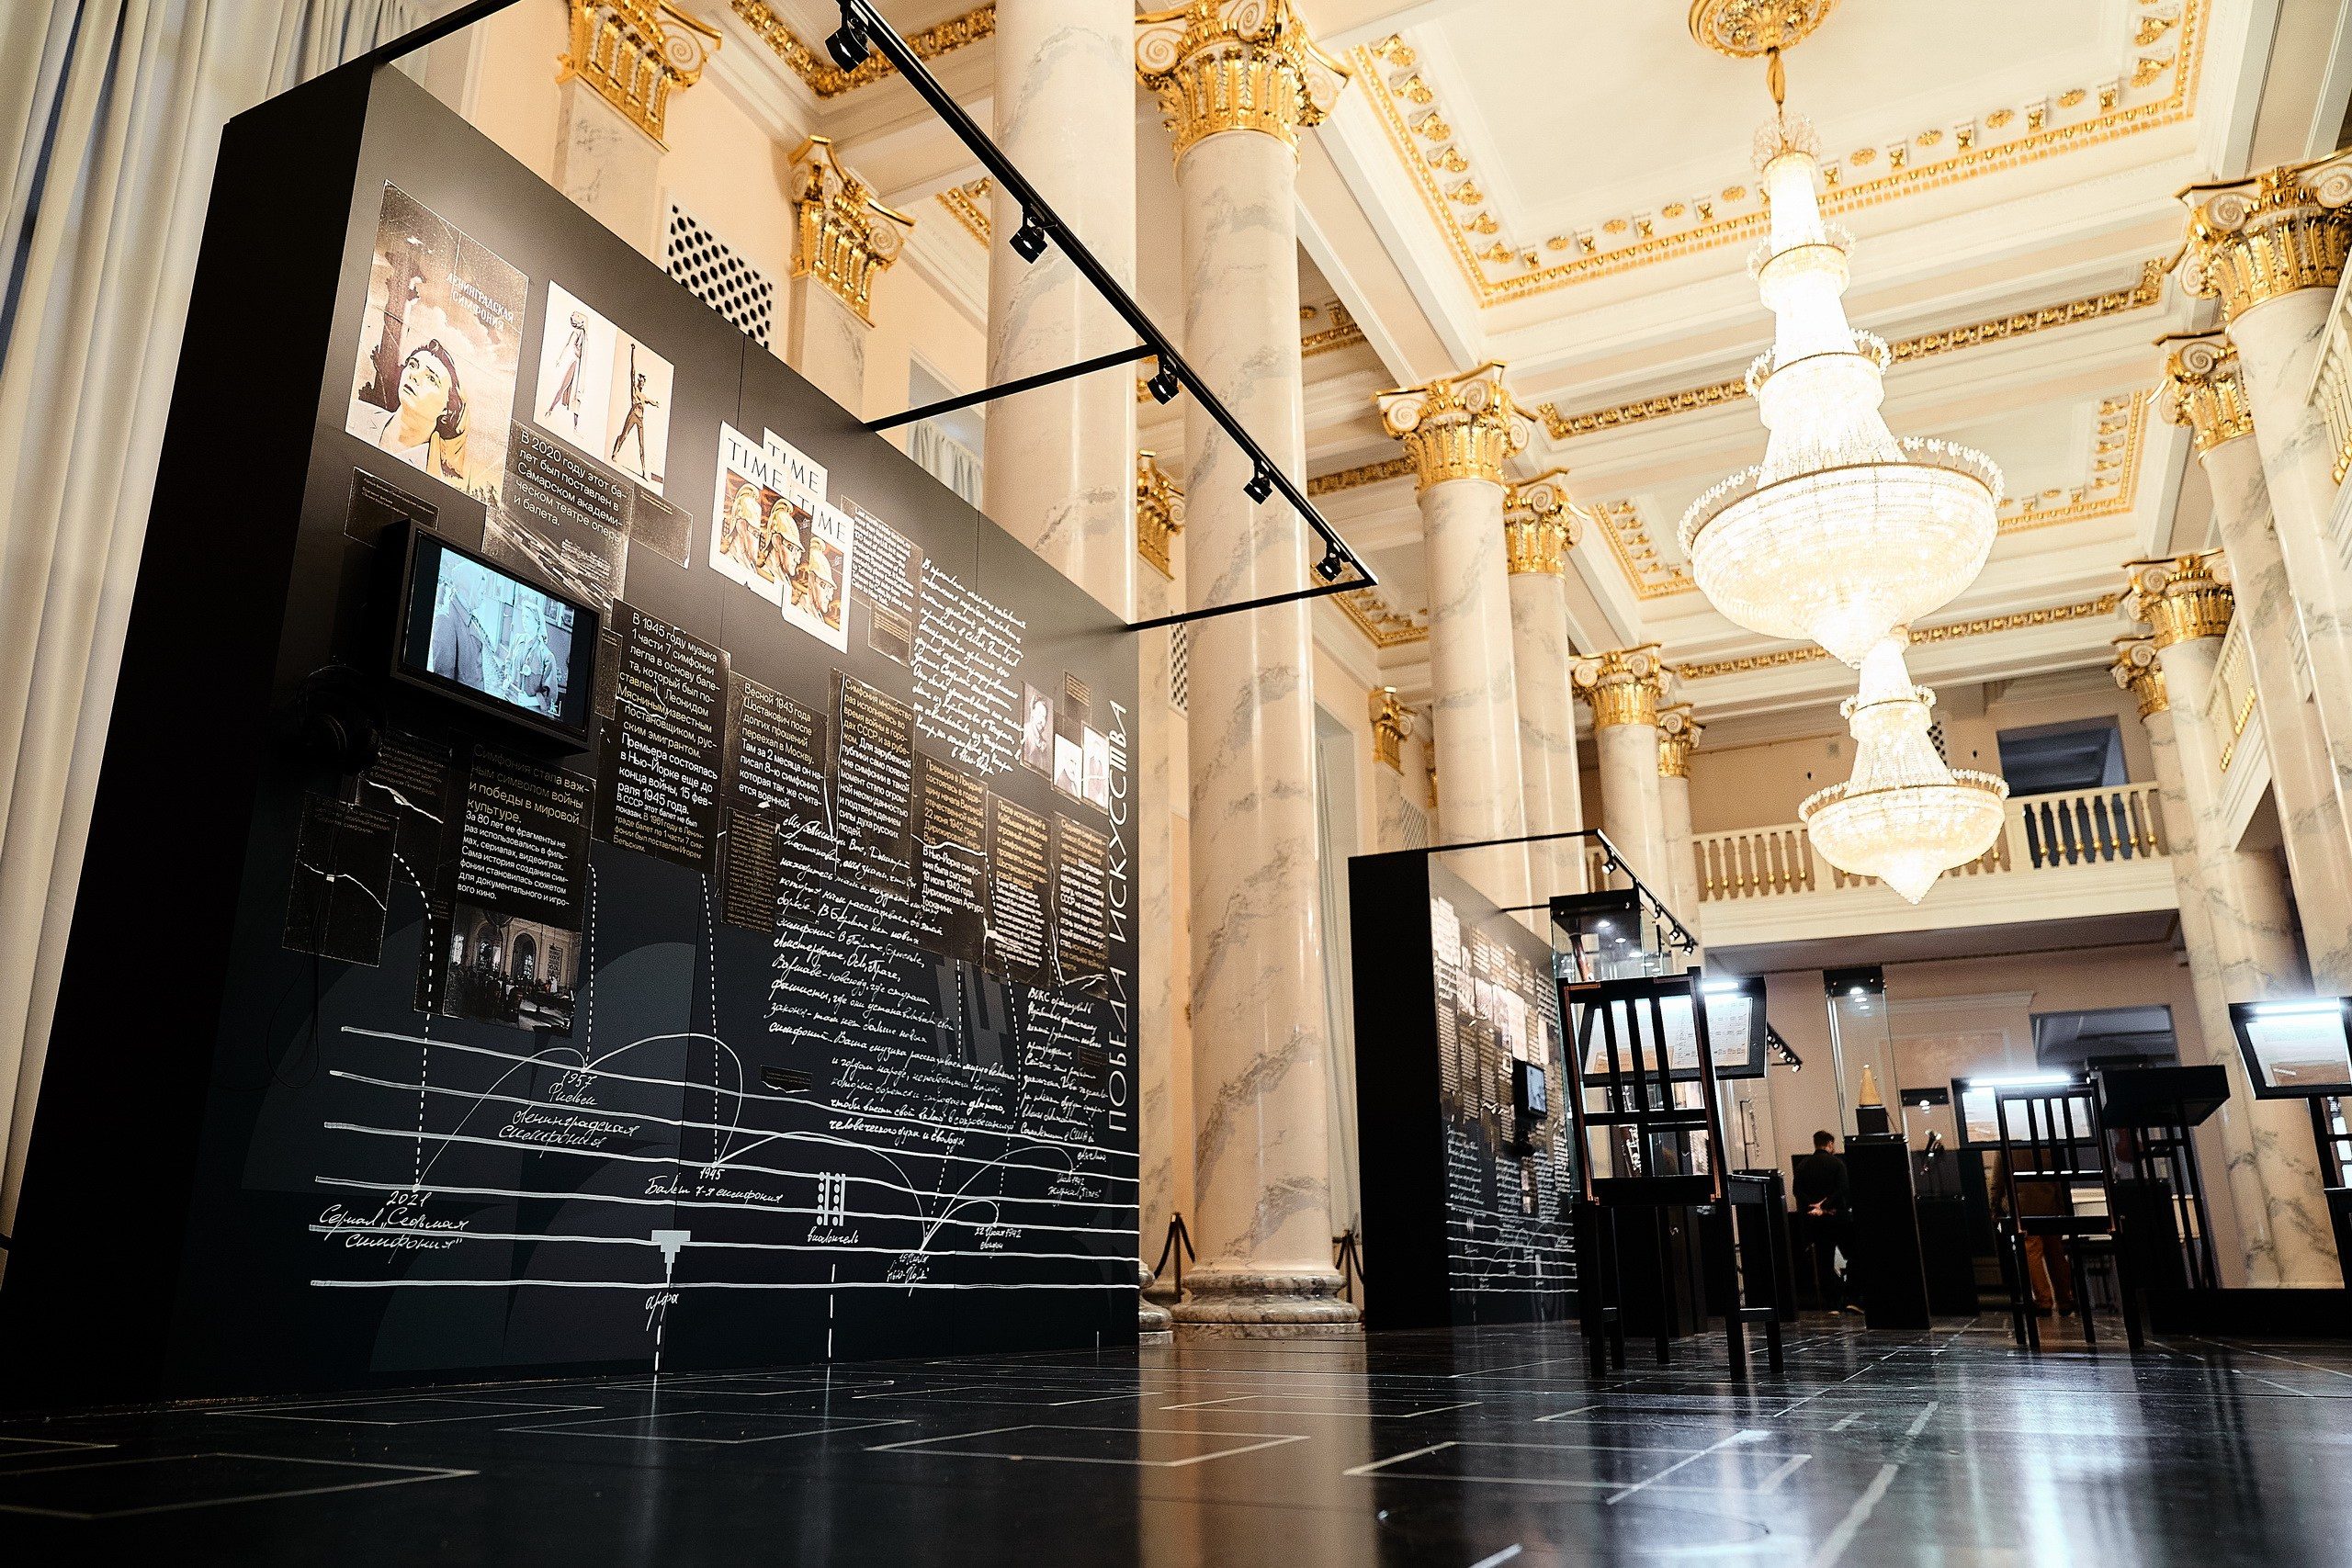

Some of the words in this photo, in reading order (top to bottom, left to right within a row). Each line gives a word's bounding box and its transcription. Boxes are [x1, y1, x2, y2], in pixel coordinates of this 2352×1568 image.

[452, 290, 504, 333] СИМФОНИЯ
[519, 428, 529, 444] В
[531, 436, 561, 462] 2020
[562, 457, 586, 479] году
[587, 468, 611, 490] этот
[610, 479, 628, 499] ба-
[519, 449, 538, 465] лет
[539, 458, 560, 479] был
[561, 472, 612, 507] поставлен
[613, 502, 619, 512] в
[729, 437, 782, 493] TIME
[767, 441, 819, 494] TIME
[514, 479, 553, 506] ческом
[555, 501, 590, 525] театре
[514, 494, 521, 505] и
[523, 498, 560, 526] балета.
[517, 461, 575, 502] Самарском
[576, 497, 623, 530] академи-
[797, 494, 846, 544] TIME
[631, 628, 637, 639] 1
[638, 633, 663, 652] части
[665, 642, 672, 654] 7
[672, 645, 714, 676] симфонии
[632, 613, 640, 630] В
[642, 617, 665, 637] 1945
[666, 629, 686, 649] году
[687, 642, 717, 662] музыка
[628, 660, 641, 673] та,
[642, 666, 681, 690] который
[681, 682, 698, 698] был
[699, 692, 715, 703] по-
[629, 645, 655, 663] легла
[656, 657, 662, 666] в
[663, 661, 695, 682] основу
[695, 673, 720, 691] бале-
[619, 671, 655, 694] ставлен
[664, 688, 708, 716] Леонидом
[744, 682, 774, 705] Весной
[775, 696, 794, 714] 1943
[794, 708, 811, 723] года
[624, 705, 696, 743] постановщиком,
[696, 735, 718, 748] рус-
[665, 707, 712, 733] известным
[742, 714, 771, 731] долгих
[771, 725, 808, 748] прошений
[743, 695, 791, 726] Шостакович
[790, 720, 812, 736] после
[621, 731, 667, 761] Премьера
[669, 754, 718, 780] состоялась
[623, 720, 646, 736] ским
[648, 730, 701, 759] эмигрантом.
[741, 727, 778, 749] переехал
[779, 742, 784, 751] в
[785, 742, 814, 765] Москву.
[741, 737, 756, 753] Там
[756, 747, 766, 758] за
[766, 748, 773, 761] 2
[774, 754, 801, 773] месяца
[801, 766, 811, 776] он
[811, 770, 824, 780] на-
[496, 773, 549, 797] символом
[551, 791, 583, 809] войны
[533, 768, 562, 785] стала
[563, 778, 590, 793] важ-
[618, 766, 647, 784] конца
[648, 777, 678, 796] войны,
[680, 785, 690, 799] 15
[691, 791, 713, 806] фев-
[620, 750, 627, 760] в
[628, 750, 680, 780] Нью-Йорке
[681, 774, 699, 788] еще
[700, 782, 713, 793] до
[739, 769, 771, 788] которая
[772, 782, 785, 794] так
[786, 787, 797, 798] же
[797, 792, 822, 807] счита-
[740, 754, 763, 771] писал
[763, 761, 781, 777] 8-ю
[781, 772, 820, 795] симфонию,
[467, 798, 522, 823] культуре.
[469, 781, 477, 791] и
[479, 784, 524, 807] победы
[525, 799, 532, 809] в
[534, 803, 580, 825] мировой
[617, 782, 640, 797] раля
[642, 787, 665, 806] 1945
[666, 799, 689, 815] года.
[739, 784, 757, 796] ется
[757, 790, 791, 809] военной.
[463, 824, 478, 834] раз
[479, 829, 540, 852] использовались
[546, 847, 568, 860] филь-
[466, 809, 476, 821] За
[477, 813, 490, 825] 80
[490, 820, 504, 829] лет
[504, 825, 515, 833] ее
[515, 827, 557, 845] фрагменты
[556, 840, 566, 849] не
[461, 845, 482, 859] Сама
[482, 853, 514, 868] история
[515, 863, 550, 878] создания
[551, 874, 569, 883] сим-
[462, 836, 479, 847] мах,
[480, 840, 518, 859] сериалах,
[518, 852, 563, 871] видеоиграх.
[457, 883, 475, 894] вого
[476, 888, 497, 899] кино.
[458, 872, 475, 881] для
[475, 876, 542, 899] документального
[548, 896, 570, 906] игро-
[459, 858, 485, 872] фонии
[485, 866, 533, 886] становилась
[534, 880, 566, 894] сюжетом
[1109, 966, 1127, 1132] ПОБЕДА
[560, 1070, 599, 1089] 1957
[513, 1103, 640, 1136] Ленинградская
[644, 1172, 691, 1195] Балет
[699, 1167, 725, 1180] 1945
[386, 1190, 433, 1208] 2021
